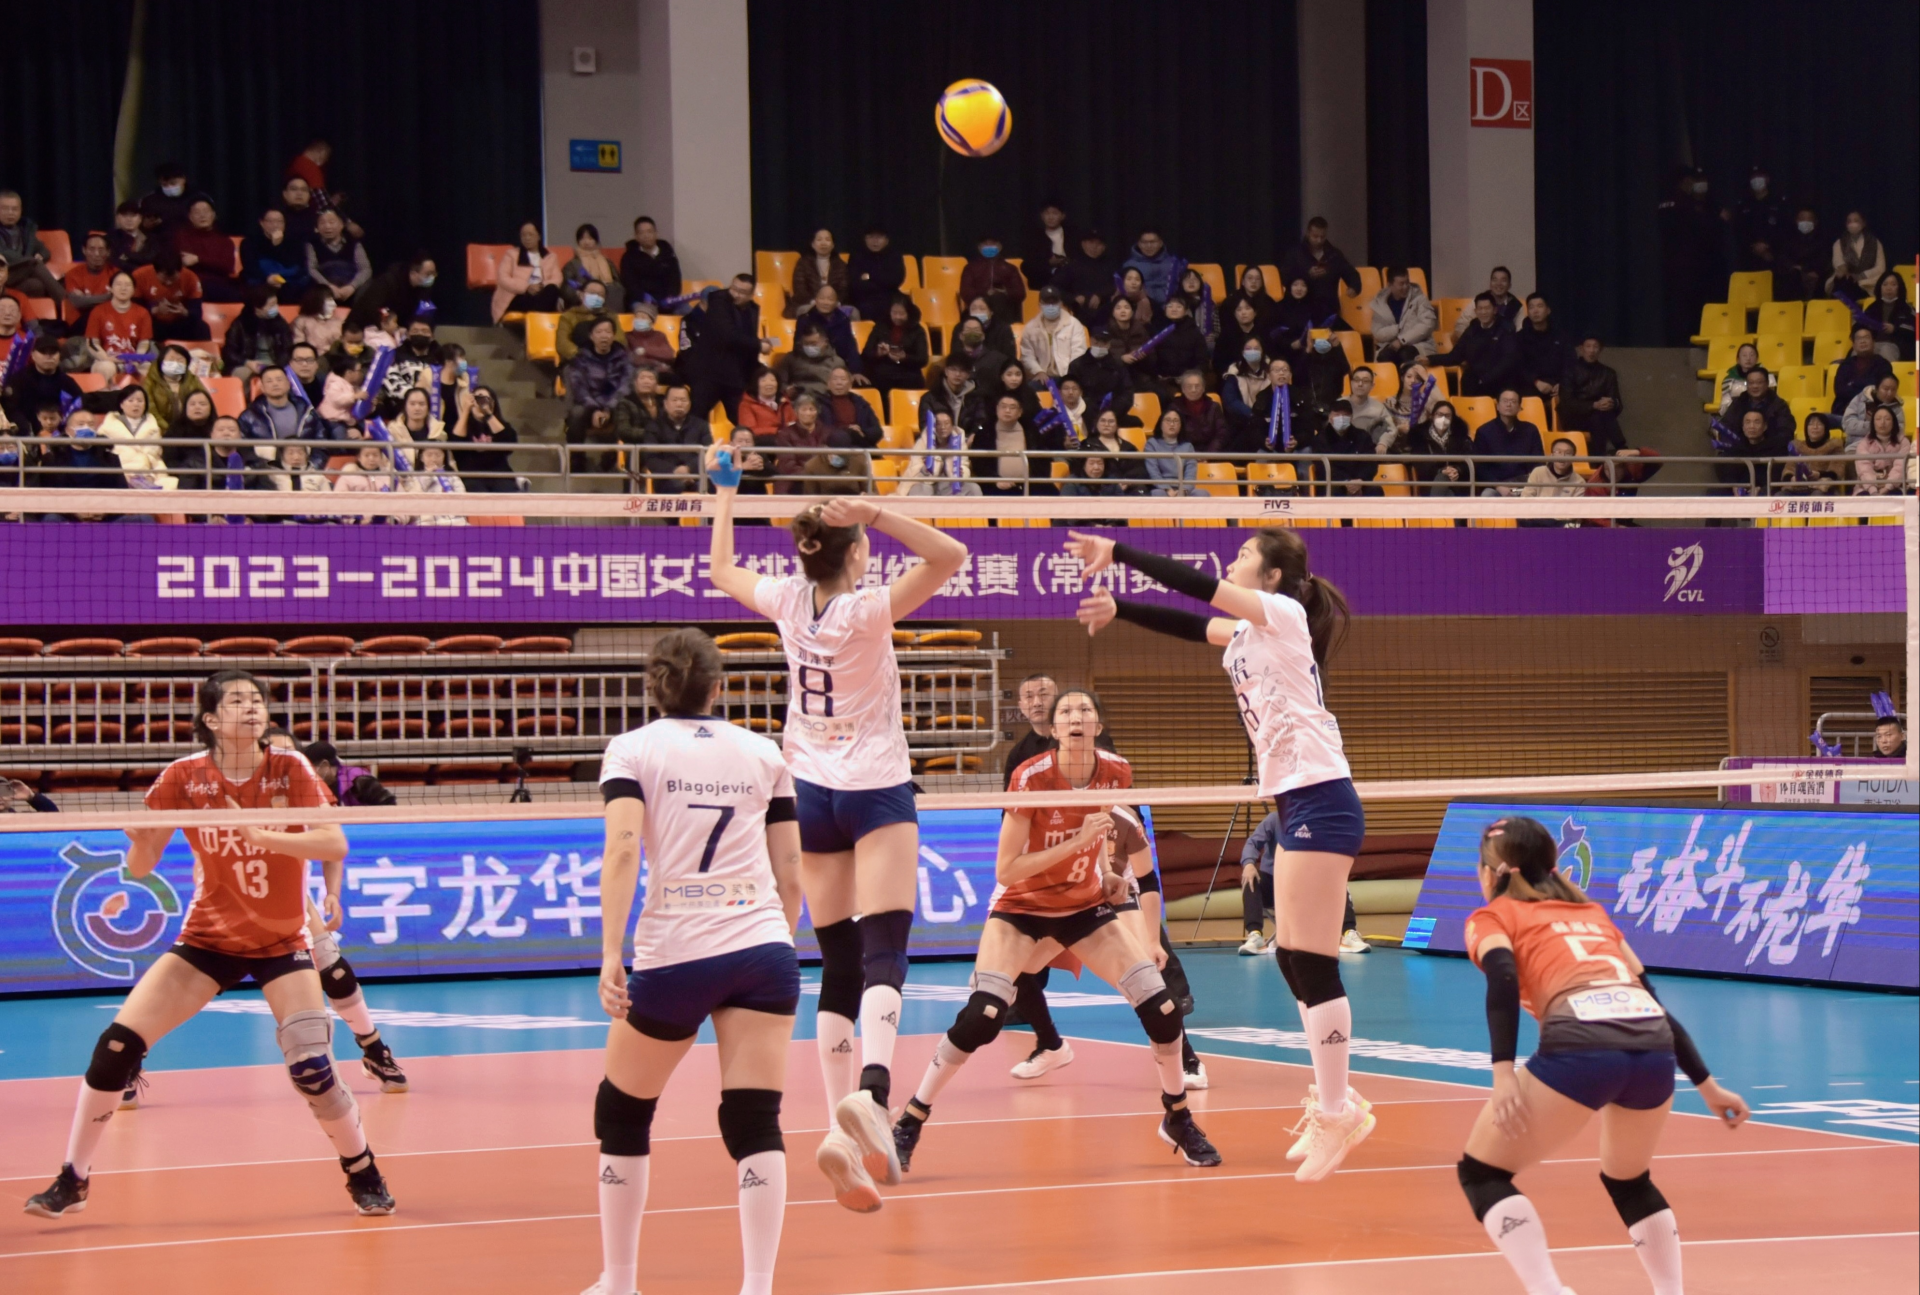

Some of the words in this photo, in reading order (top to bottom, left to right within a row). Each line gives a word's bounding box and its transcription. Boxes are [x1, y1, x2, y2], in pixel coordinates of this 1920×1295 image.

[1677, 589, 1705, 602] CVL
[667, 779, 754, 797] Blagojevic
[687, 803, 736, 874] 7
[1294, 830, 1313, 839] PEAK
[231, 858, 270, 899] 13
[1066, 855, 1090, 884] 8
[663, 884, 726, 898] MBO
[1563, 935, 1632, 985] 5
[1573, 990, 1631, 1008] MBO
[1321, 1036, 1348, 1046] PEAK
